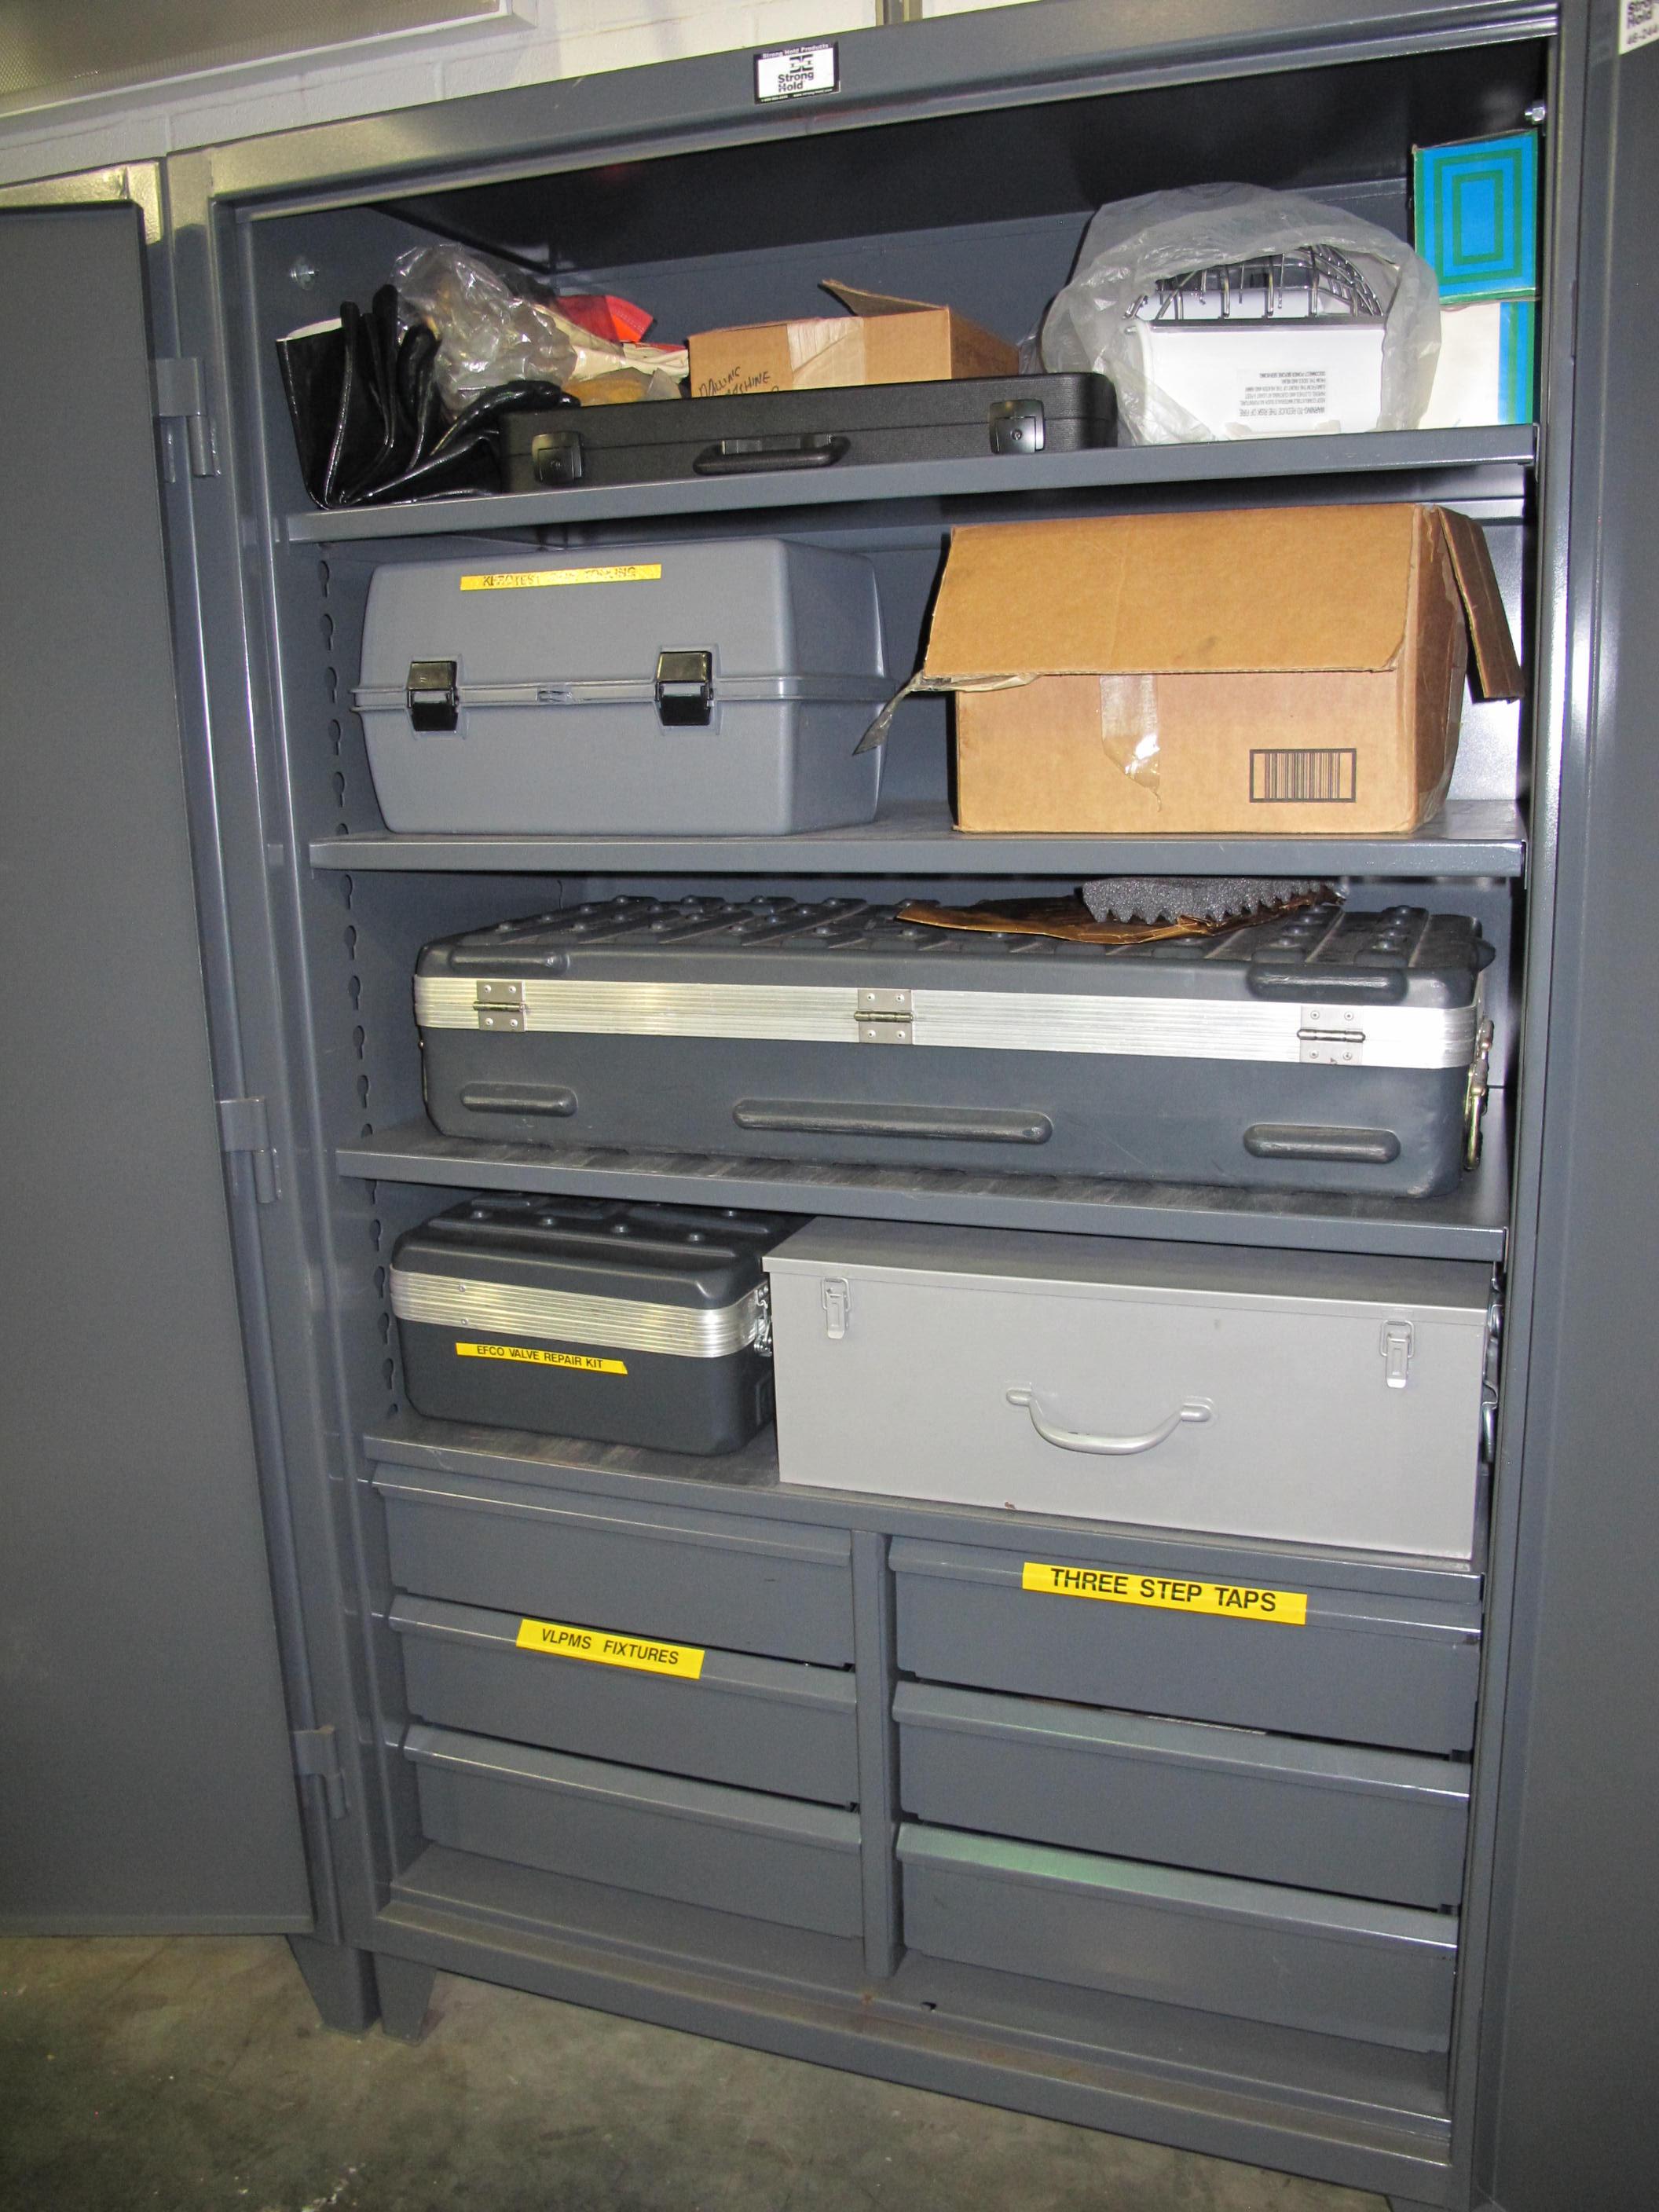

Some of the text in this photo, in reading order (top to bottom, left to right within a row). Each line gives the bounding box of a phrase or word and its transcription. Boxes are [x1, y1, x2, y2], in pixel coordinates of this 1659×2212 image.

[801, 44, 829, 53] Products
[778, 71, 814, 83] Strong
[778, 82, 803, 93] Hold
[477, 1345, 603, 1369] EFCO VALVE REPAIR KIT
[1050, 1568, 1276, 1612] THREE STEP TAPS
[542, 1628, 679, 1664] VLPMS FIXTURES
